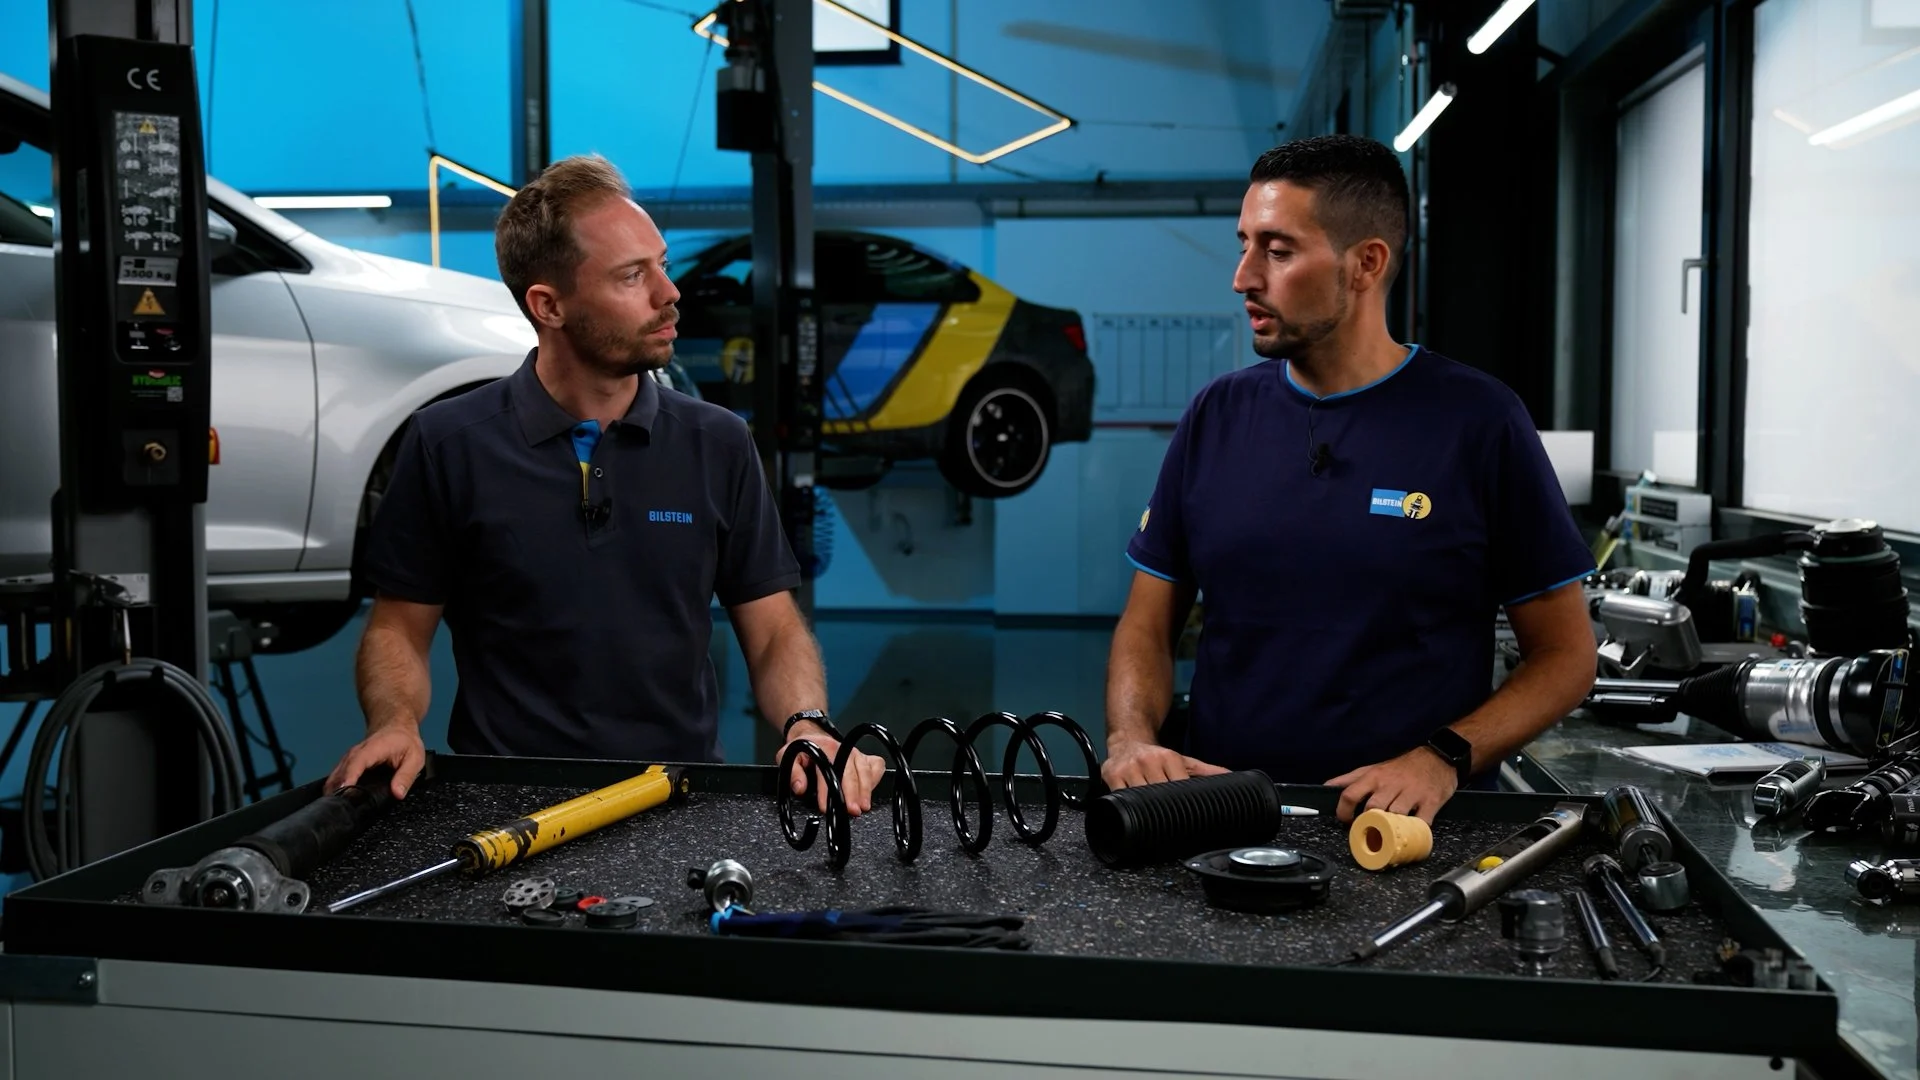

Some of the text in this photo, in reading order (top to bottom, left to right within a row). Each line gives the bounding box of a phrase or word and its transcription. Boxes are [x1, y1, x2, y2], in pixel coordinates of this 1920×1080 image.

[127, 67, 162, 91] CE
[123, 269, 172, 281] 3500 kg
[1372, 497, 1403, 508] BILSTEIN
[649, 511, 693, 524] BILSTEIN
